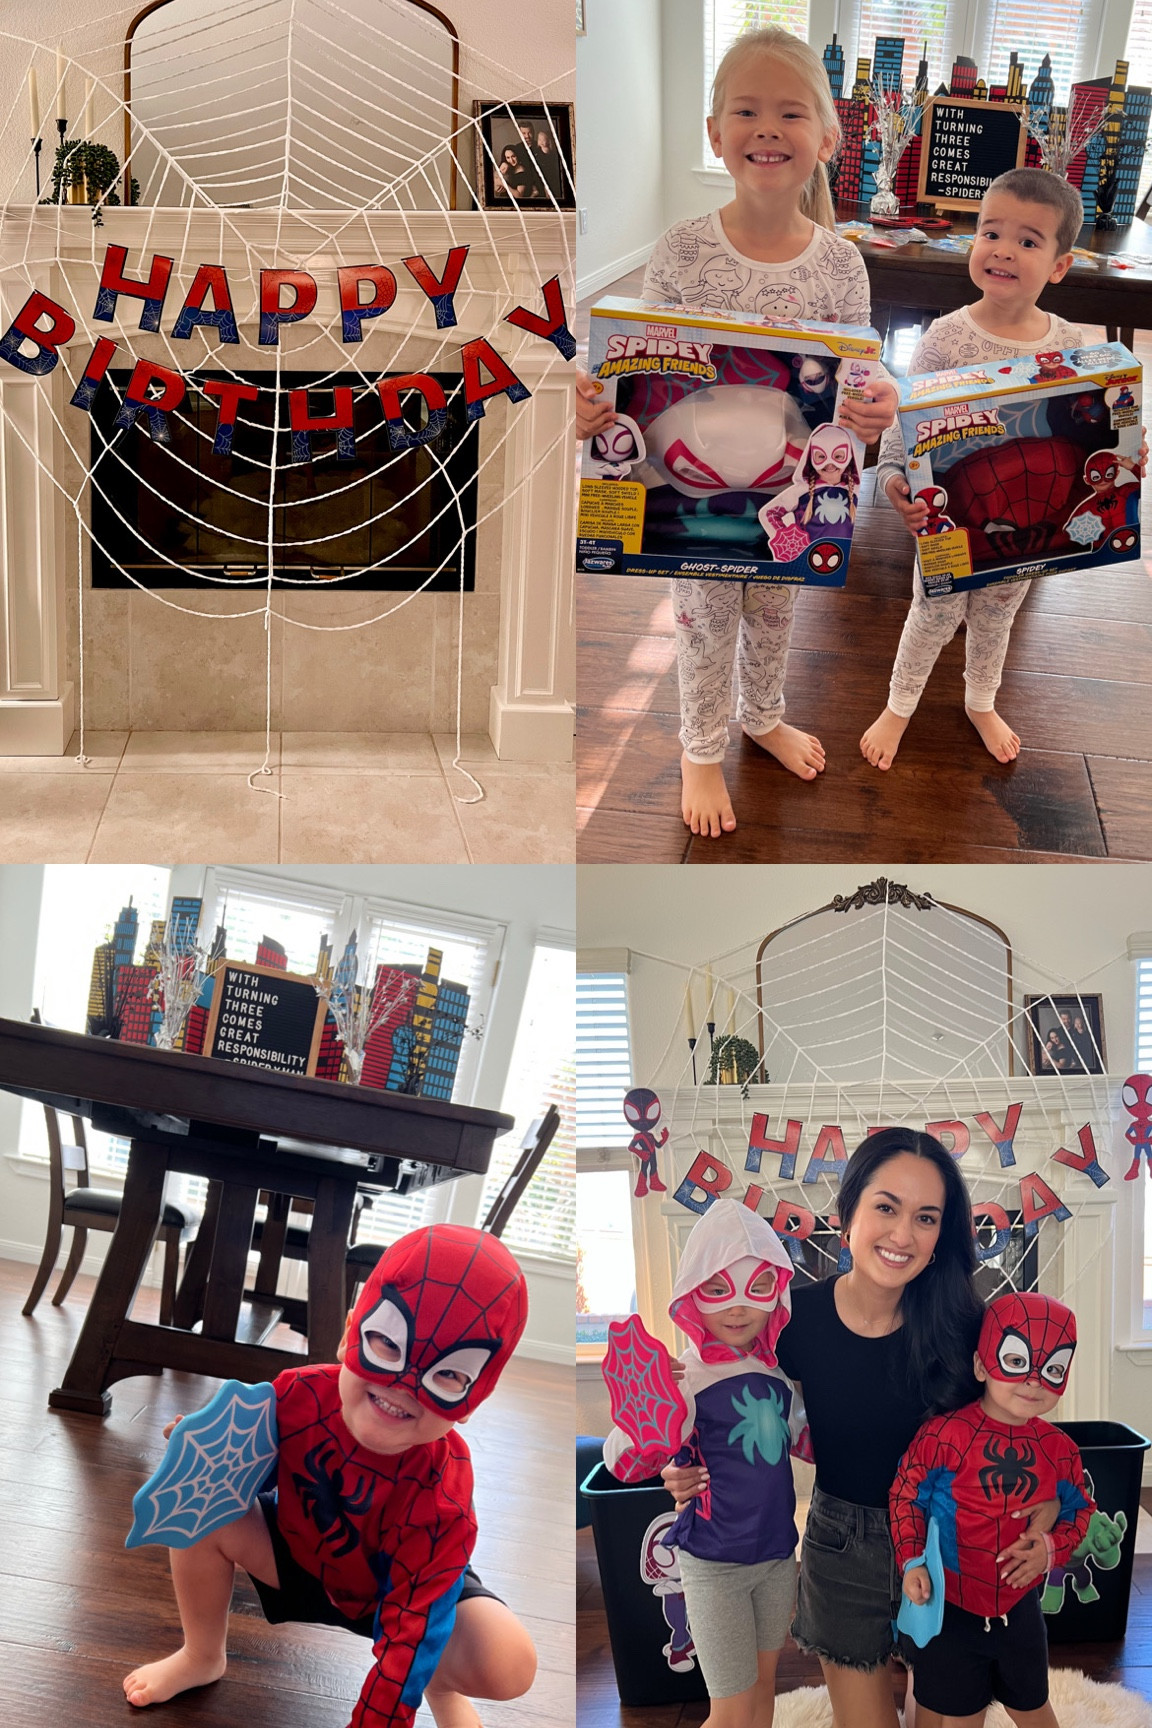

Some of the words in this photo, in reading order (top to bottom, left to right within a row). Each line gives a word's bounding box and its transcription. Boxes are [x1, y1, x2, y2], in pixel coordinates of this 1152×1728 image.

[937, 107, 964, 119] WITH
[936, 121, 983, 134] TURNING
[935, 133, 971, 146] THREE
[933, 147, 970, 159] COMES
[932, 160, 968, 171] GREAT
[92, 243, 471, 346] HAPPY
[647, 325, 676, 338] MARVEL
[606, 334, 712, 364] SPIDEY
[837, 342, 864, 355] Disney
[0, 275, 576, 463] BIRTHDAY
[598, 358, 660, 379] AMAZING
[662, 358, 716, 379] FRIENDS
[912, 370, 986, 391] SPIDEY
[910, 382, 952, 400] AMAZING
[944, 404, 969, 416] MARVEL
[916, 408, 999, 442] SPIDEY
[913, 430, 960, 457] AMAZING
[962, 425, 1005, 439] FRIENDS
[680, 562, 758, 574] GHOST-SPIDER
[1016, 563, 1047, 574] SPIDEY
[228, 971, 259, 987] WITH
[226, 985, 279, 1006] TURNING
[225, 999, 264, 1017] THREE
[222, 1013, 262, 1031] COMES
[220, 1027, 259, 1044] GREAT
[217, 1040, 306, 1067] RESPONSIBILITY
[744, 1102, 1023, 1184] HAPY
[673, 1122, 1110, 1272] BRDAY
